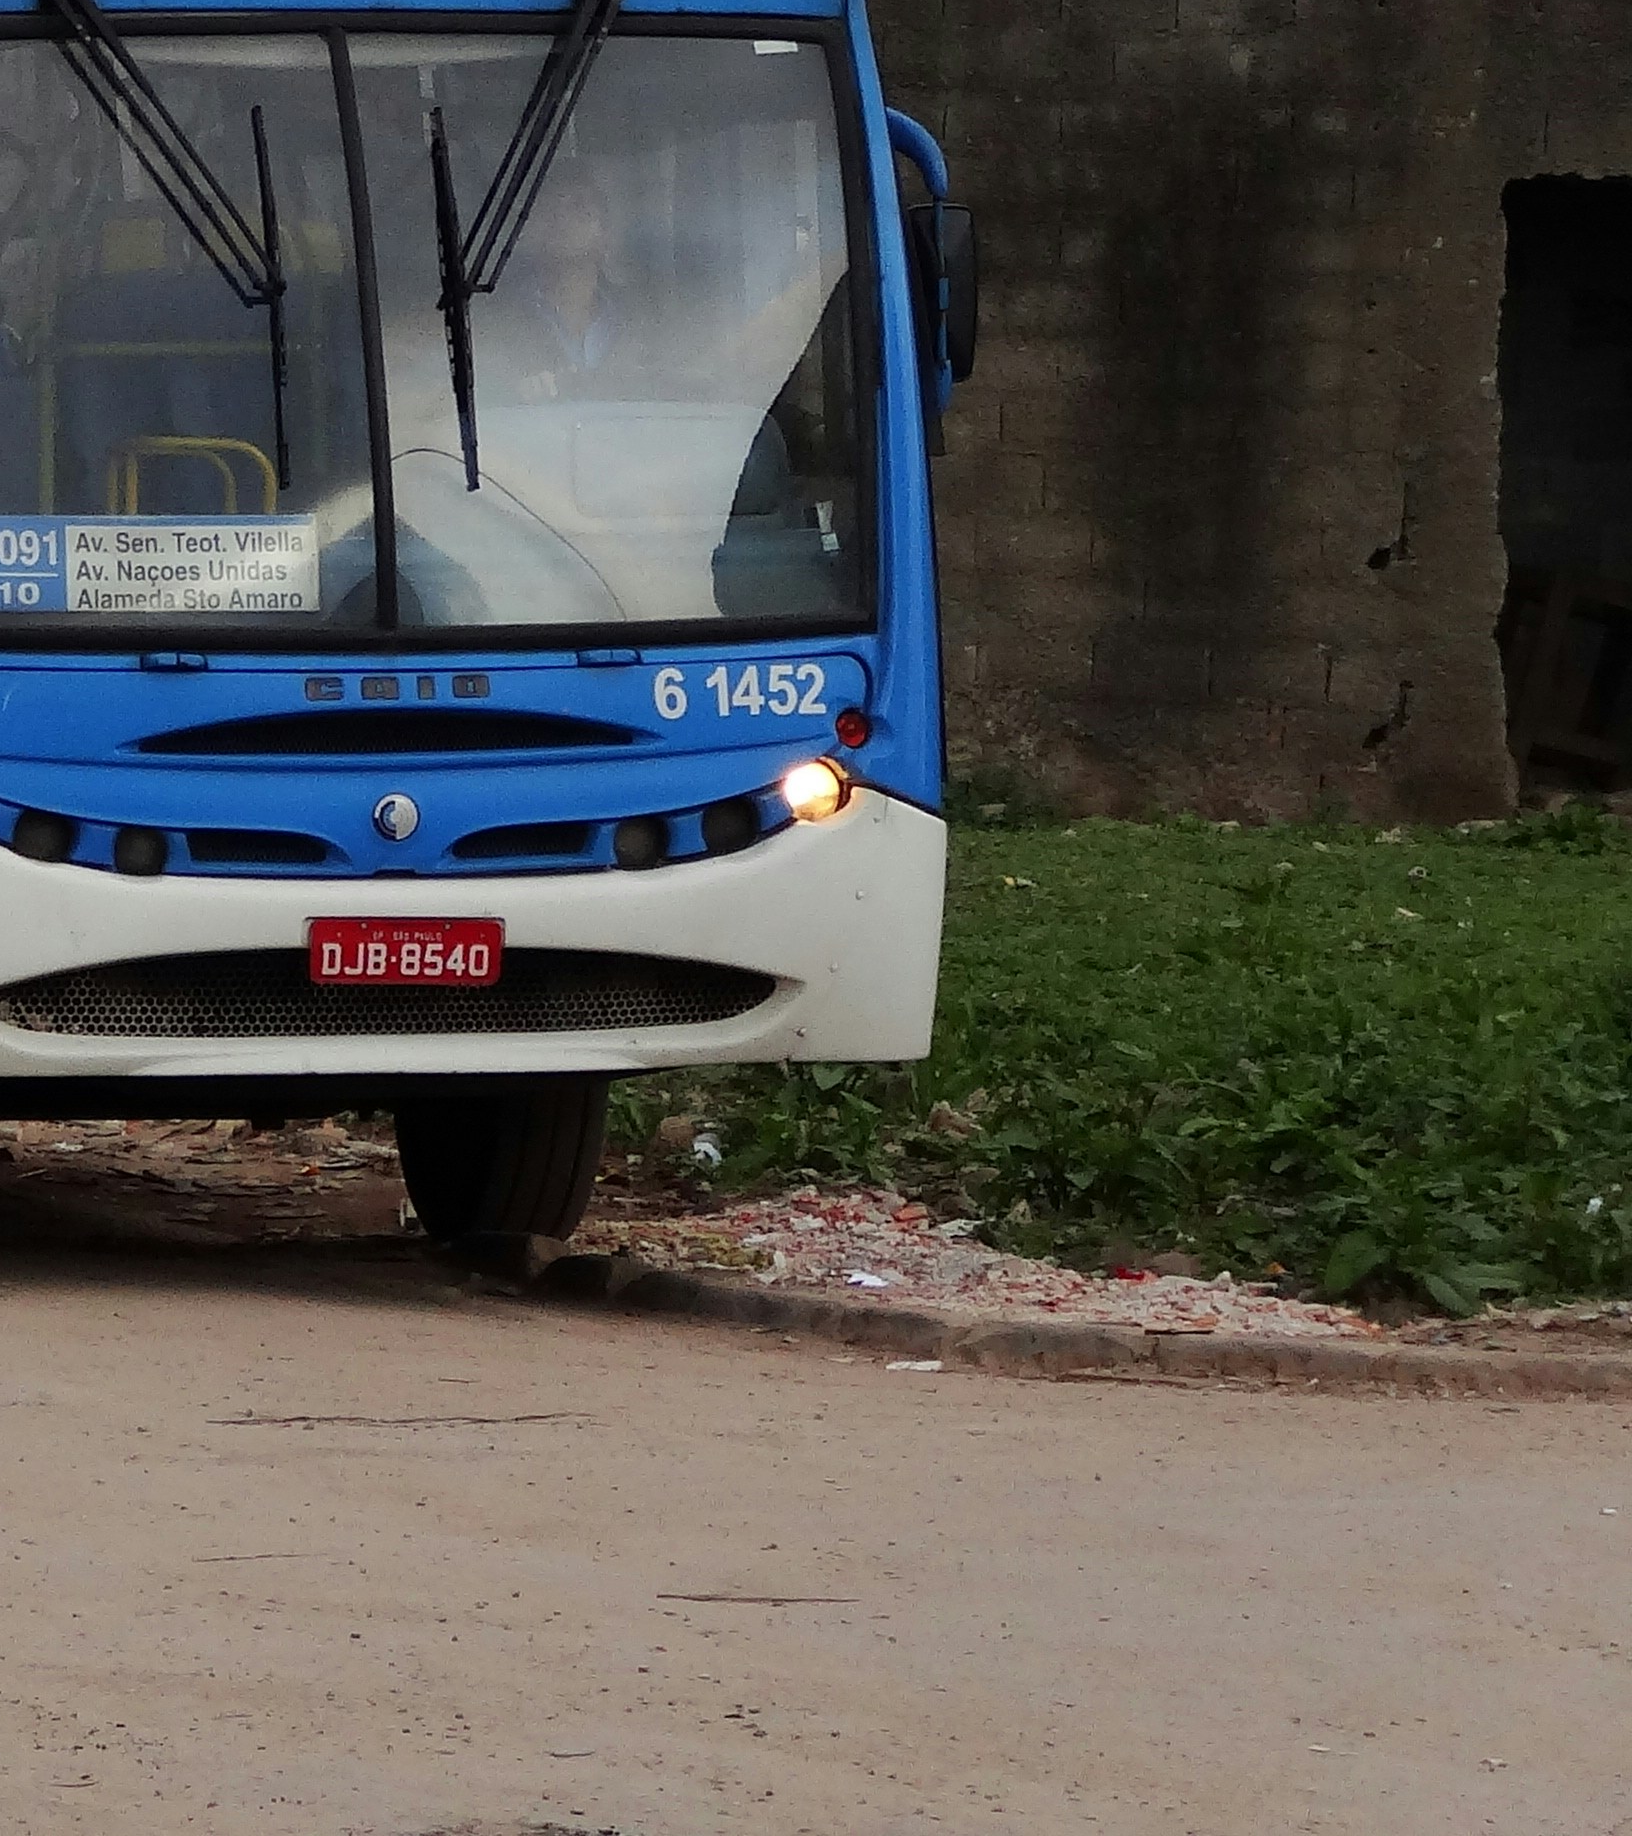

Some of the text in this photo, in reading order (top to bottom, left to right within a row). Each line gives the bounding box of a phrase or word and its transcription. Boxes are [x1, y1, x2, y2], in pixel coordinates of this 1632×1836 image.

[74, 532, 109, 554] Av.
[115, 533, 166, 554] Sen.
[172, 532, 228, 554] Teot.
[236, 531, 303, 553] Vilella
[76, 561, 288, 588] Av. Naçoes Unidas
[78, 589, 304, 610] Alameda Sto Amaro
[653, 663, 827, 720] 6 1452
